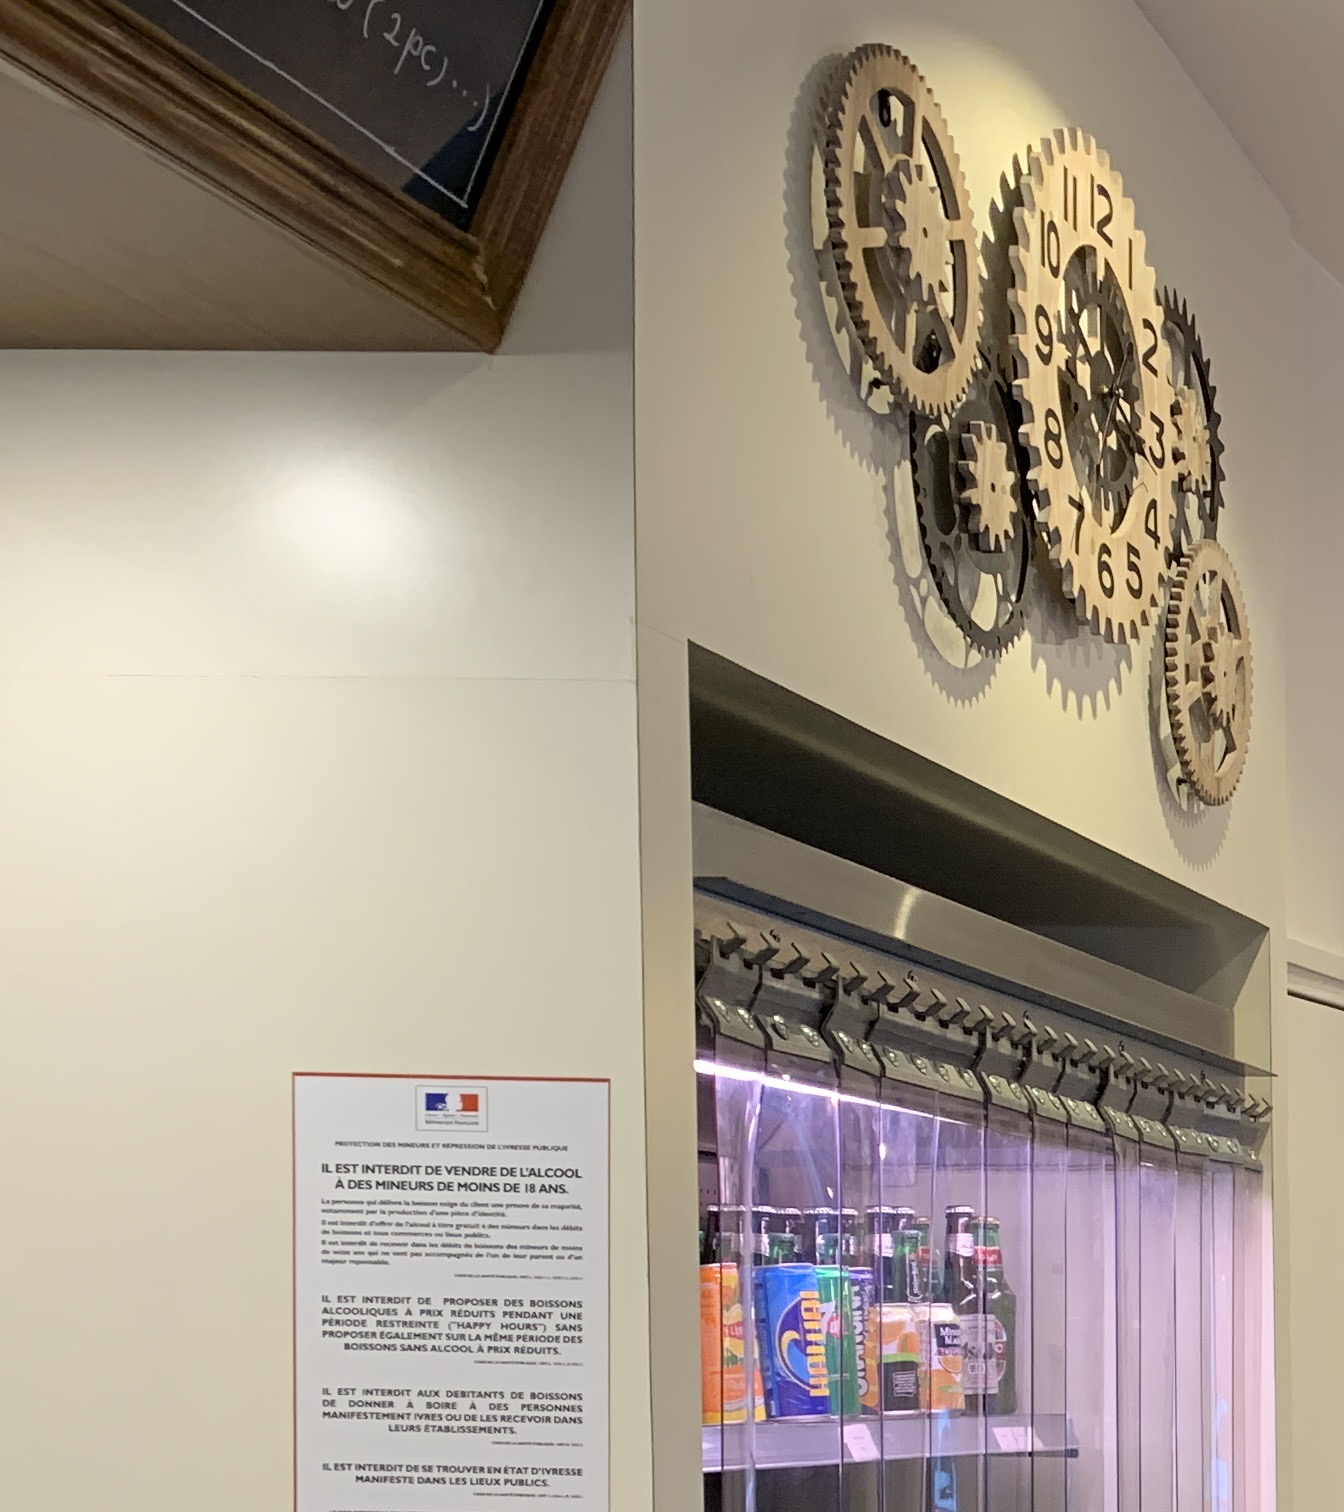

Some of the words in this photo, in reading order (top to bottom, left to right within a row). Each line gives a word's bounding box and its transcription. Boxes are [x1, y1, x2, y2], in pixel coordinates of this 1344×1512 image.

[1062, 165, 1079, 231] 11
[1089, 174, 1115, 247] 12
[1038, 209, 1062, 280] 10
[1126, 236, 1135, 290] 1
[1033, 303, 1055, 367] 9
[1141, 317, 1159, 376] 2
[1042, 406, 1064, 470] 8
[1147, 410, 1165, 469] 3
[1068, 494, 1085, 554] 7
[1144, 497, 1161, 549] 4
[1097, 543, 1115, 599] 6
[1125, 542, 1143, 599] 5
[321, 1163, 332, 1173] IL
[335, 1163, 359, 1174] EST
[361, 1163, 422, 1175] INTERDIT
[424, 1165, 442, 1175] DE
[443, 1165, 497, 1176] VENDRE
[499, 1166, 517, 1177] DE
[519, 1166, 582, 1178] L'ALCOOL
[334, 1176, 344, 1189] À
[347, 1179, 372, 1190] DES
[375, 1179, 434, 1191] MINEURS
[436, 1180, 454, 1191] DE
[457, 1181, 500, 1192] MOINS
[502, 1182, 520, 1193] DE
[524, 1182, 535, 1193] 18
[538, 1183, 568, 1194] ANS.
[321, 1294, 331, 1302] IL
[336, 1294, 356, 1303] EST
[361, 1295, 411, 1304] INTERDIT
[417, 1296, 431, 1305] DE
[442, 1297, 498, 1306] PROPOSER
[503, 1298, 524, 1307] DES
[529, 1298, 582, 1308] BOISSONS
[321, 1306, 398, 1317] ALCOOLIQUES
[404, 1306, 412, 1316] À
[419, 1308, 443, 1317] PRIX
[450, 1307, 495, 1318] RÉDUITS
[501, 1310, 553, 1319] PENDANT
[559, 1311, 582, 1320] UNE
[375, 1319, 439, 1329] RESTREINTE
[554, 1323, 582, 1332] SANS
[321, 1329, 377, 1339] PROPOSER
[378, 1330, 443, 1340] ÉGALEMENT
[444, 1332, 466, 1341] SUR
[467, 1333, 482, 1341] LA
[483, 1331, 513, 1342] MÊME
[562, 1335, 582, 1343] DES
[343, 1342, 397, 1351] BOISSONS
[399, 1343, 428, 1352] SANS
[429, 1343, 473, 1353] ALCOOL
[476, 1343, 484, 1353] À
[486, 1345, 510, 1353] PRIX
[513, 1344, 561, 1355] RÉDUITS.
[322, 1387, 331, 1395] IL
[337, 1387, 356, 1396] EST
[361, 1387, 411, 1397] INTERDIT
[416, 1389, 440, 1397] AUX
[510, 1391, 524, 1399] DE
[529, 1391, 583, 1401] BOISSONS
[321, 1398, 335, 1407] DE
[347, 1399, 394, 1408] DONNER
[405, 1398, 414, 1408] À
[425, 1400, 457, 1410] BOIRE
[468, 1399, 476, 1409] À
[488, 1402, 508, 1411] DES
[520, 1403, 583, 1413] PERSONNES
[321, 1410, 411, 1420] MANIFESTEMENT
[413, 1412, 443, 1421] IVRES
[444, 1413, 462, 1421] OU
[463, 1413, 477, 1421] DE
[479, 1414, 498, 1422] LES
[499, 1414, 551, 1423] RECEVOIR
[553, 1415, 582, 1424] DANS
[388, 1423, 421, 1432] LEURS
[423, 1423, 517, 1435] ÉTABLISSEMENTS.
[322, 1462, 331, 1470] IL
[333, 1462, 352, 1471] EST
[354, 1462, 403, 1472] INTERDIT
[405, 1464, 419, 1472] DE
[420, 1464, 433, 1473] SE
[435, 1464, 485, 1474] TROUVER
[486, 1465, 501, 1474] EN
[503, 1465, 529, 1475] ÉTAT
[530, 1466, 582, 1476] D'IVRESSE
[354, 1474, 414, 1484] MANIFESTE
[416, 1476, 446, 1485] DANS
[448, 1476, 467, 1485] LES
[469, 1477, 500, 1486] LIEUX
[503, 1477, 549, 1487] PUBLICS.
